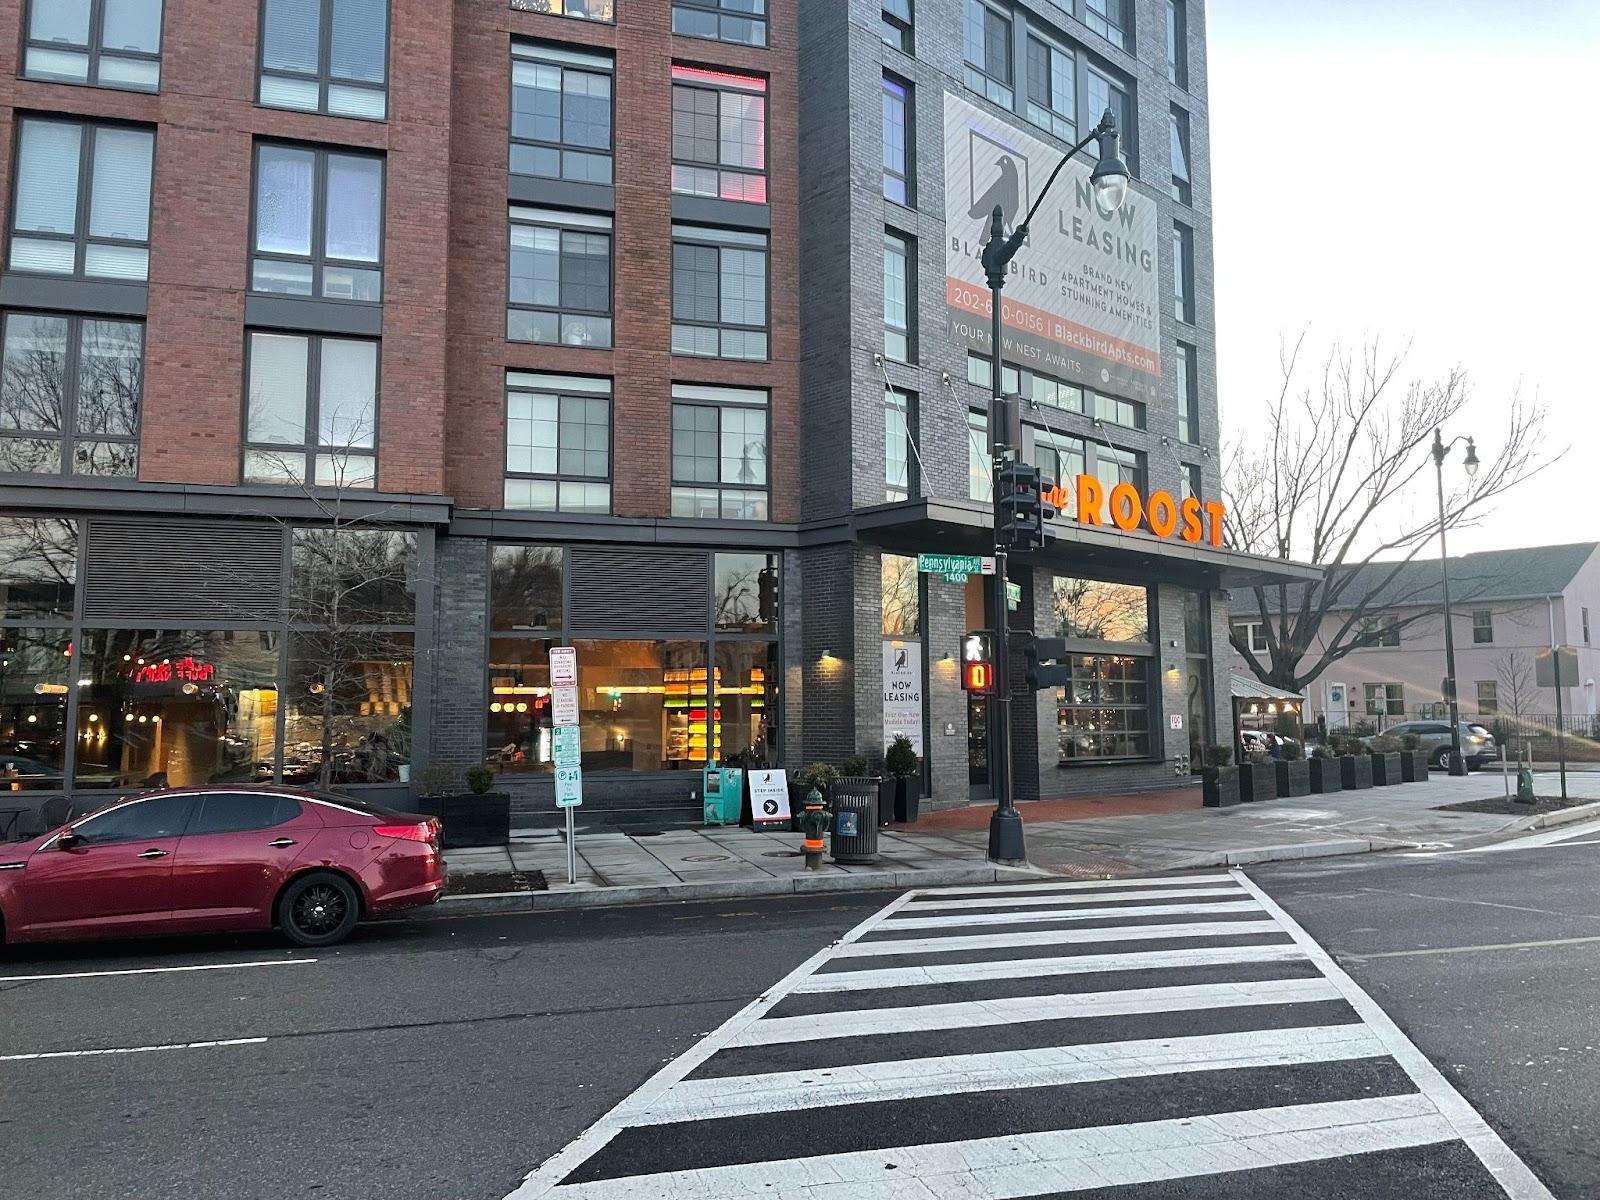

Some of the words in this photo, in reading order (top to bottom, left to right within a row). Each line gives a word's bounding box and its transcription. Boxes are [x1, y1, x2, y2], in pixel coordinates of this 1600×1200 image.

[952, 236, 1048, 286] BLABIRD
[1058, 209, 1152, 273] LEASING
[1061, 271, 1114, 301] APARTMENT
[1116, 293, 1145, 313] HOMES
[1146, 305, 1152, 316] &
[1083, 264, 1112, 285] BRAND
[1115, 279, 1133, 292] NEW
[954, 287, 1044, 331] 202-60-0156
[1054, 324, 1155, 371] BlackbirdApts.com
[1061, 285, 1107, 312] STUNNING
[1109, 304, 1153, 330] AMENITIES
[953, 320, 984, 342] YOUR
[987, 332, 1013, 351] NW
[1016, 342, 1041, 359] NEST
[1045, 352, 1081, 373] AWAITS
[1076, 472, 1227, 548] ROOST
[919, 555, 974, 573] Pennsylvania
[944, 573, 968, 582] 1400
[884, 692, 920, 702] LEASING
[892, 681, 912, 690] NOW
[972, 665, 985, 687] 0
